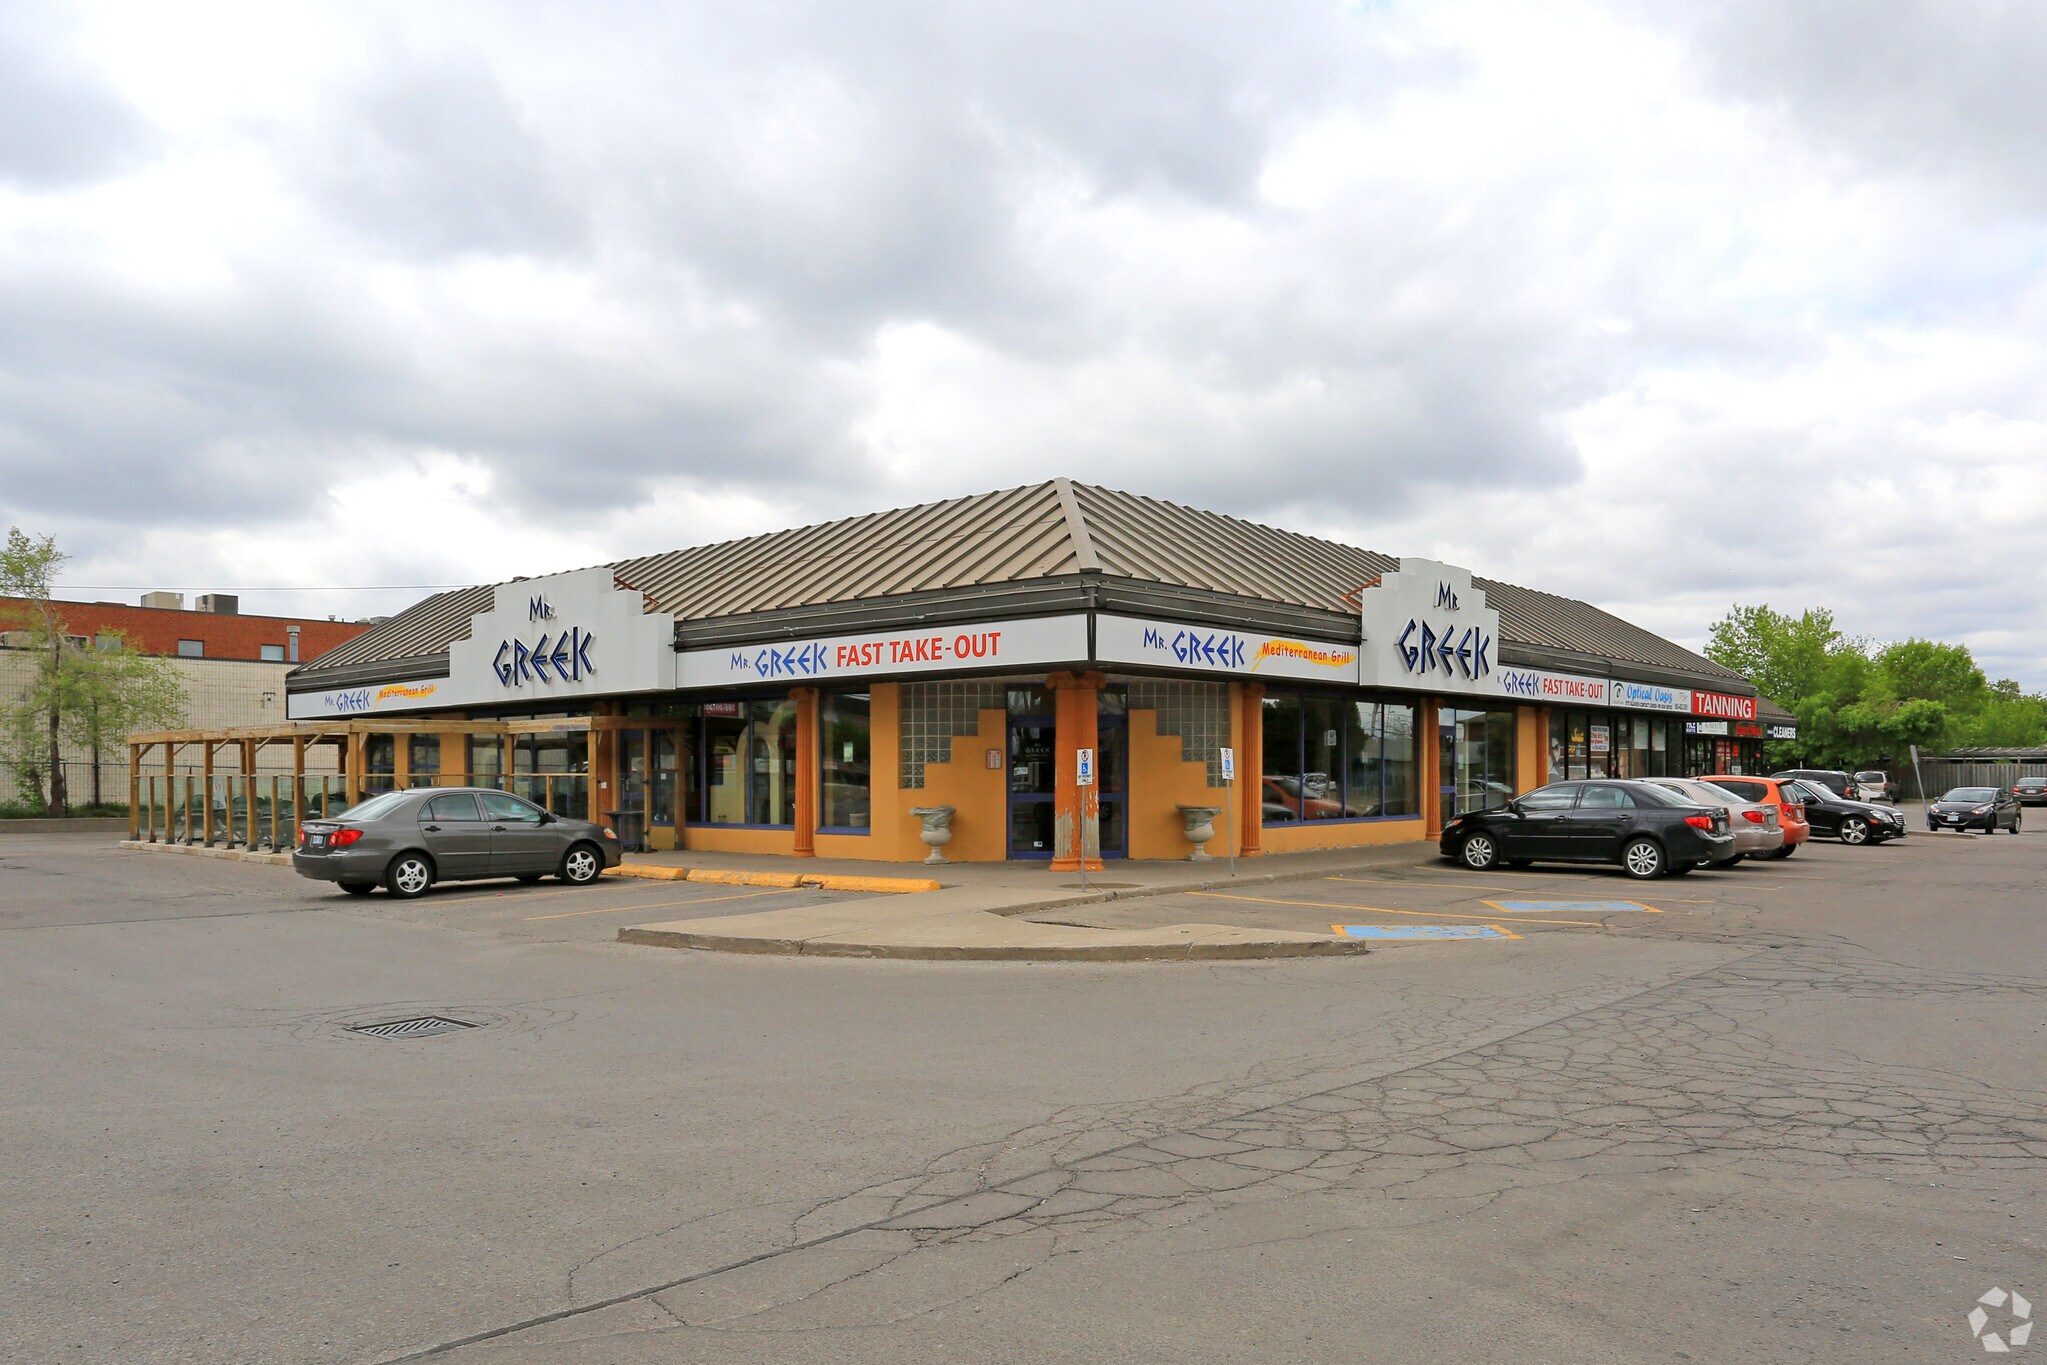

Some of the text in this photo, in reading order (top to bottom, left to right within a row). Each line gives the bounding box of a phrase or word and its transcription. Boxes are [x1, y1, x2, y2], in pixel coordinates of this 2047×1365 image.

[492, 625, 597, 688] GREEK
[754, 642, 828, 678] GREEK
[836, 642, 884, 669] FAST
[889, 631, 1001, 663] TAKE-OUT
[1172, 631, 1245, 668] GREEK
[1262, 641, 1350, 664] Mediterranean Grill
[1398, 618, 1490, 680] GREEK
[379, 684, 434, 698] Mediterranean Grill
[1503, 671, 1540, 696] GREEK
[1543, 678, 1563, 695] FAST
[1565, 681, 1604, 699] TAKE-OUT
[1627, 684, 1673, 704] Optical Oasis
[336, 689, 370, 712] GREEK
[1696, 692, 1752, 719] TANNING
[1773, 726, 1796, 739] CLEANERS
